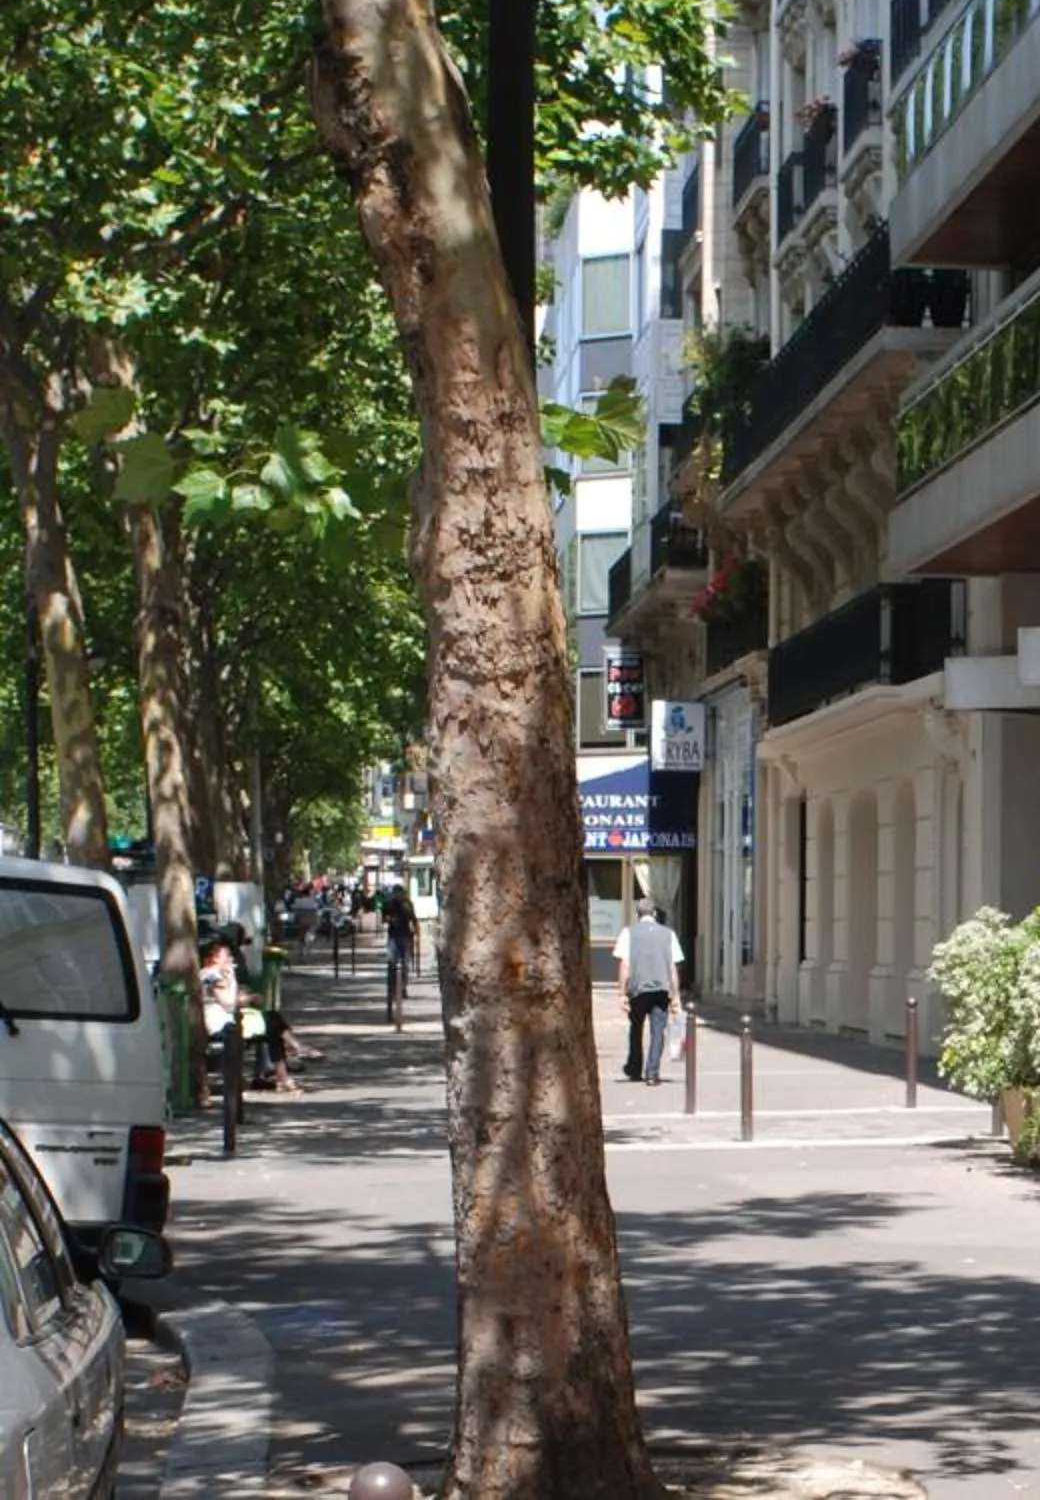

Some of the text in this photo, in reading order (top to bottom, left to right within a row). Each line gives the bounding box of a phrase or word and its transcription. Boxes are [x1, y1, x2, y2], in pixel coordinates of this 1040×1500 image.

[579, 794, 660, 808] AURANT
[584, 814, 644, 826] ONAIS
[584, 832, 695, 847] NT JAPONAIS
